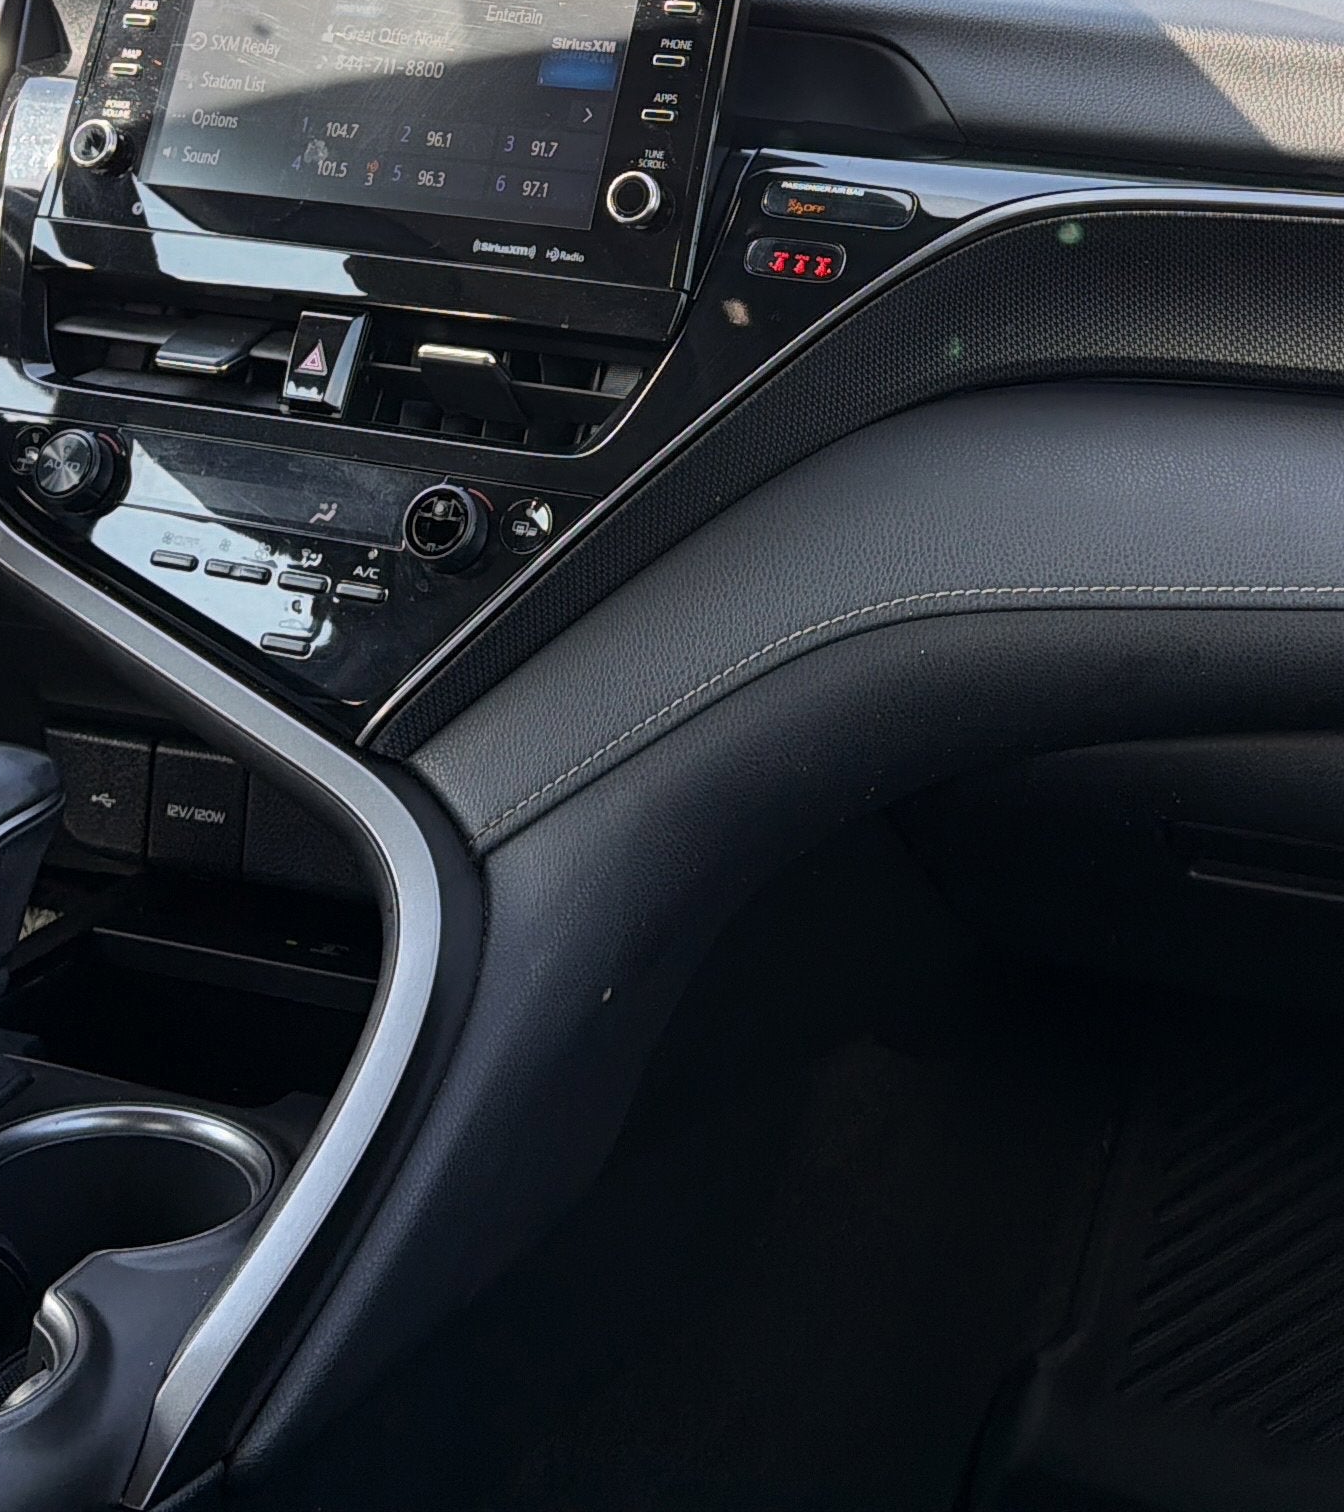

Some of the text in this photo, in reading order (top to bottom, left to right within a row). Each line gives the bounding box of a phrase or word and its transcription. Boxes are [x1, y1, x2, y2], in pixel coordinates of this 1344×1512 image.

[485, 3, 543, 26] Entertain
[121, 48, 142, 59] MAP
[210, 35, 281, 58] SXM Replay
[551, 36, 617, 54] SiriusXM
[661, 39, 693, 51] PHONE
[336, 56, 444, 80] 844-711-8800
[200, 71, 267, 92] Station List
[654, 92, 679, 104] APPS
[191, 108, 239, 129] Options
[325, 121, 360, 139] 104.7
[400, 125, 452, 148] 2 96.1
[504, 135, 558, 158] 3 91.7
[644, 148, 666, 160] TUNE
[182, 148, 220, 165] Sound
[638, 159, 667, 170] SCROLL
[291, 154, 349, 178] 4 101.5
[364, 173, 374, 186] 3
[391, 165, 446, 188] 5 96.3
[495, 175, 550, 199] 6 97.1
[780, 180, 832, 194] PASSENGER
[803, 202, 825, 214] OFF
[43, 459, 81, 473] AUTO
[352, 565, 380, 580] A/C
[166, 802, 227, 825] 12V/120W
